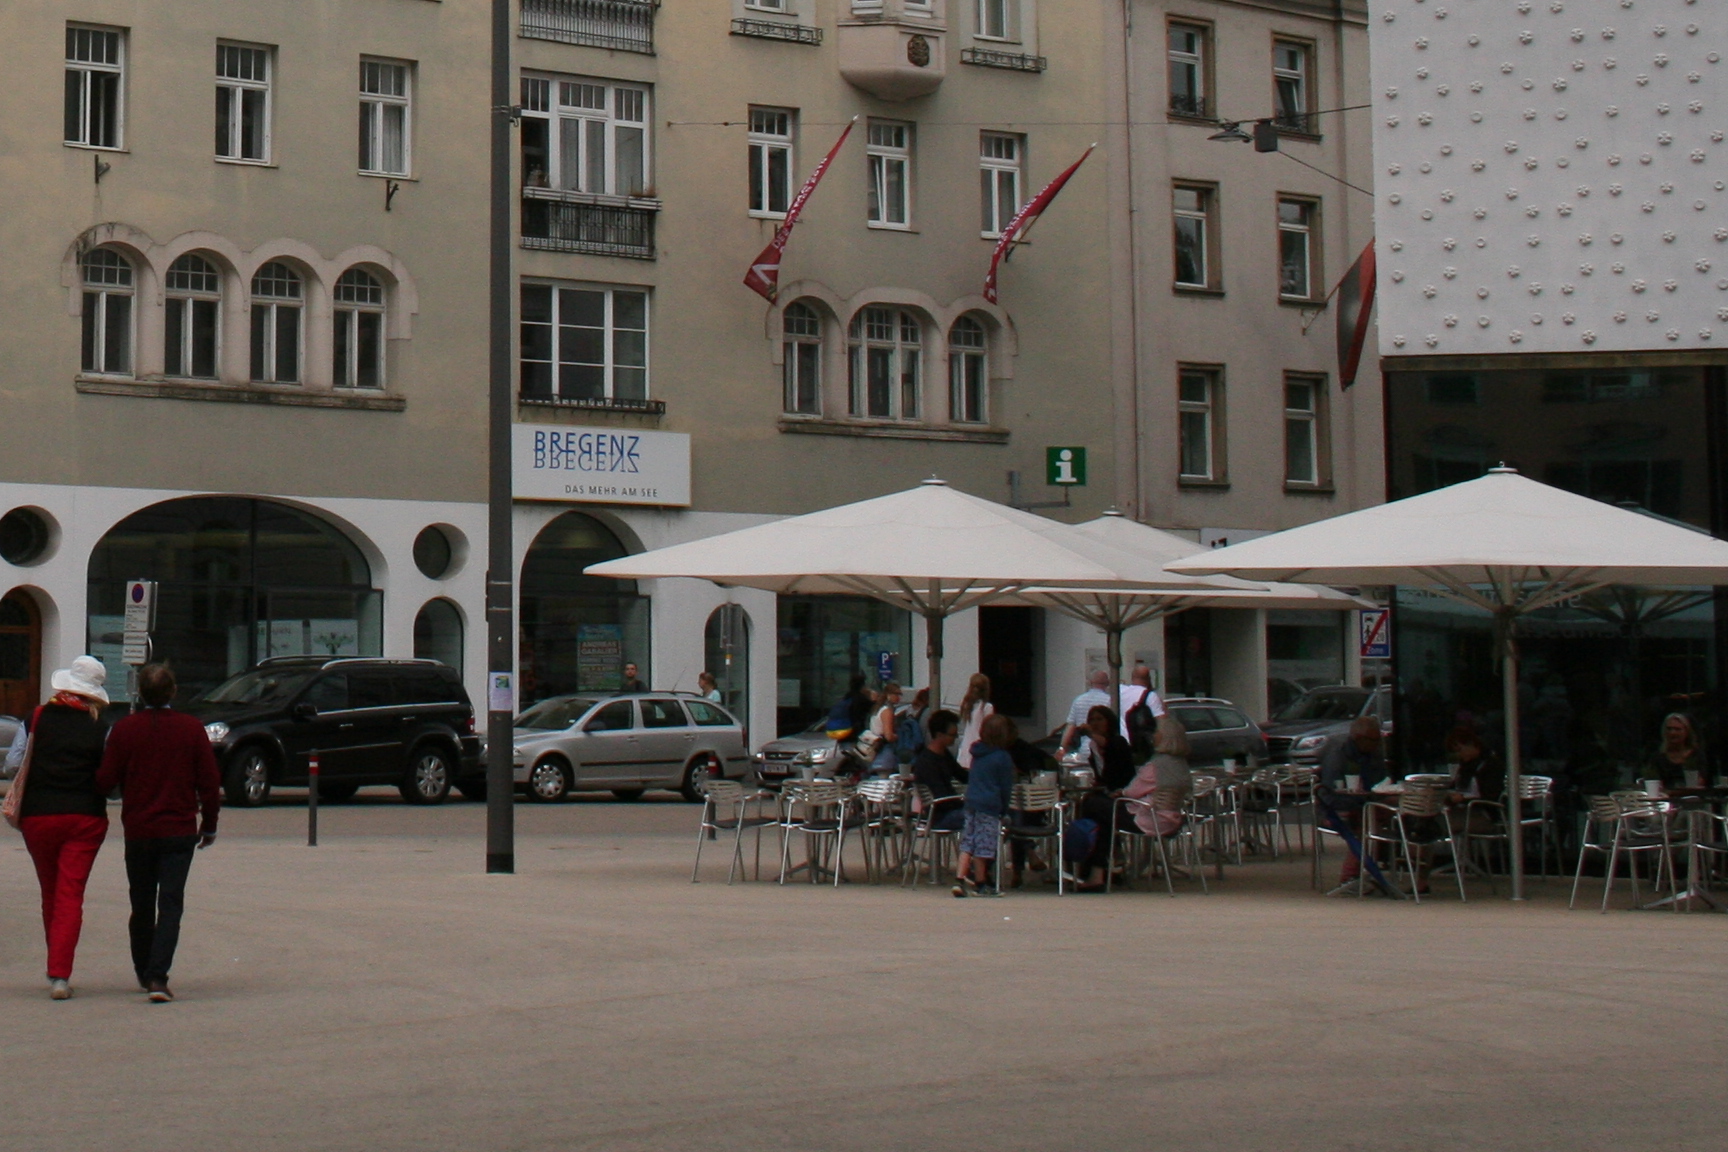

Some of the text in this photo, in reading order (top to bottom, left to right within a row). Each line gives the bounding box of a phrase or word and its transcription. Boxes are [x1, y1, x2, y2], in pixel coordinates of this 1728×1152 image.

[534, 430, 640, 458] BREGENZ
[564, 485, 659, 498] DAS MEHR AM SEE
[881, 651, 890, 665] P
